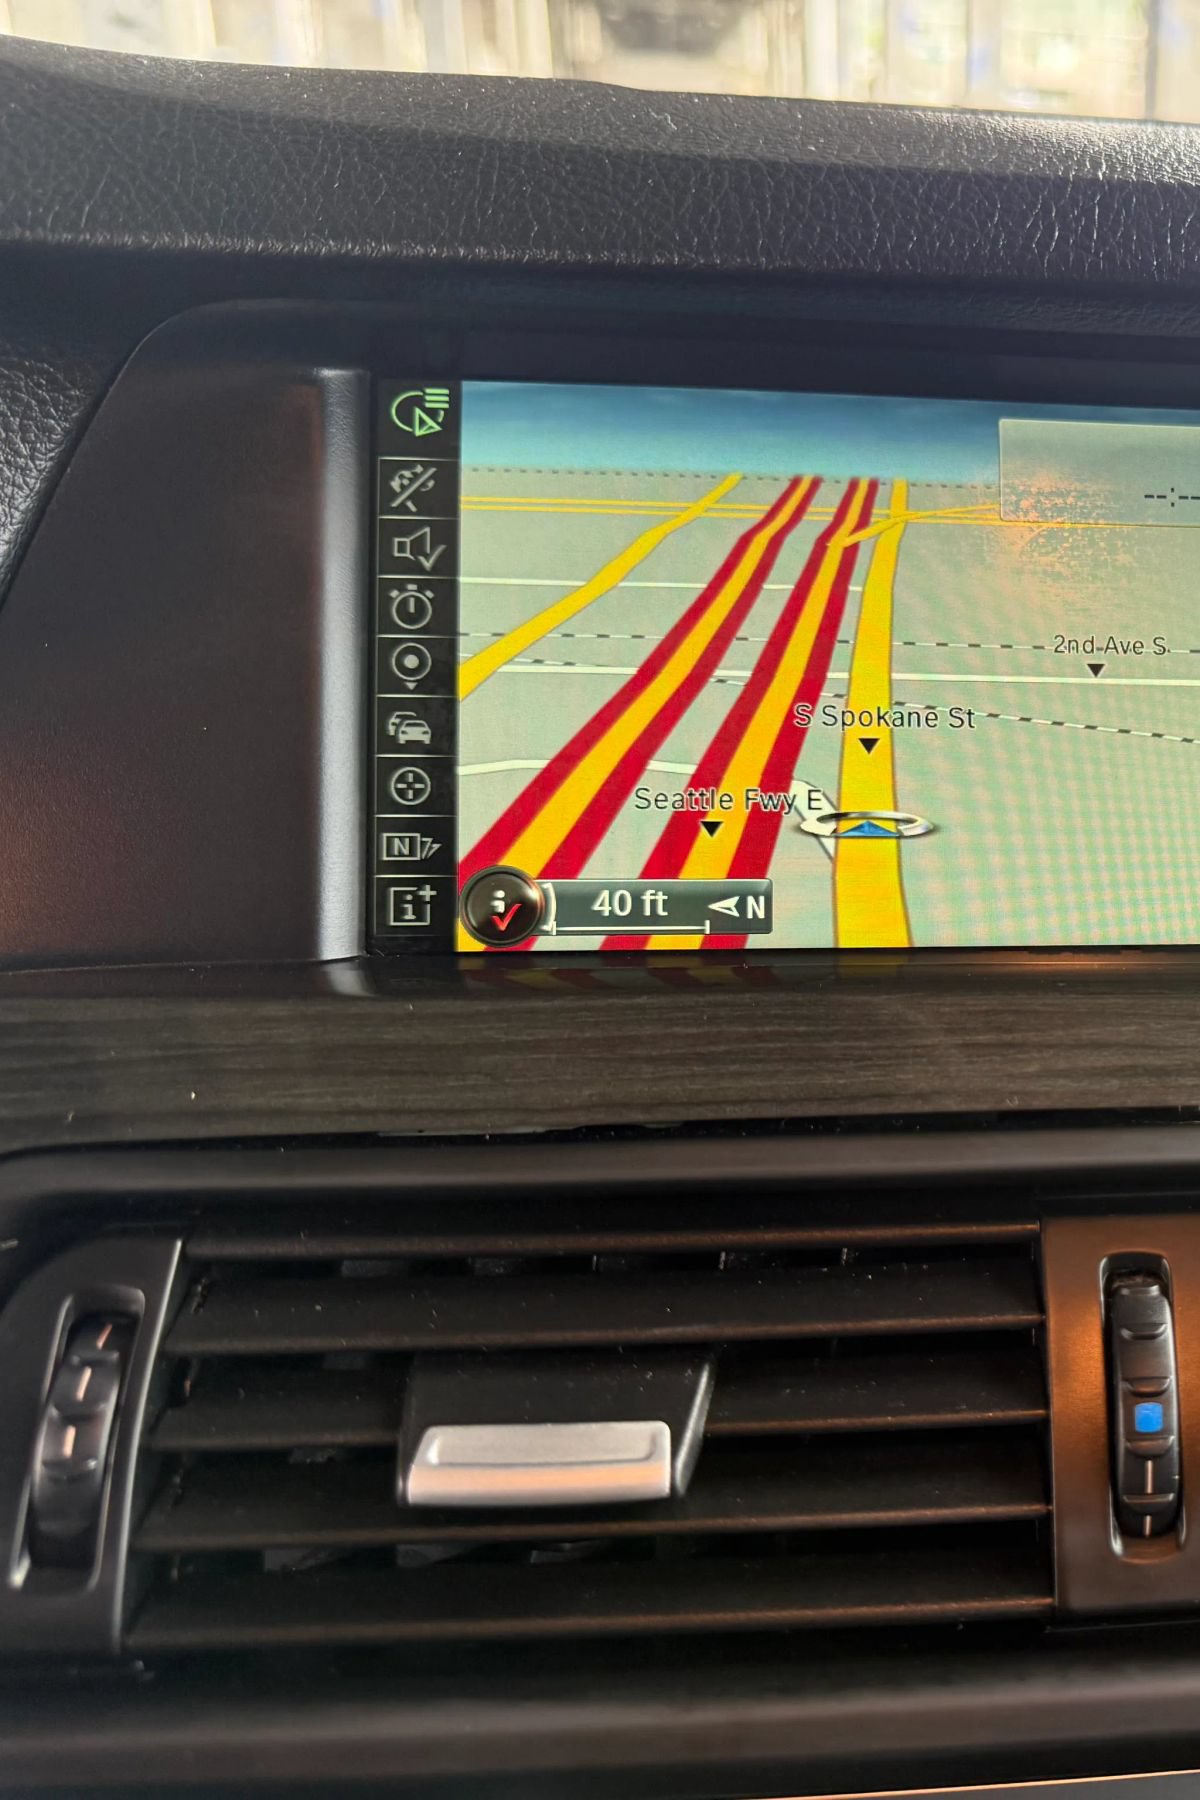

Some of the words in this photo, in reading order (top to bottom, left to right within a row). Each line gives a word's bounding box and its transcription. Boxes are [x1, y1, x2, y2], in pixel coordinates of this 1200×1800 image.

[1053, 634, 1095, 655] 2nd
[1103, 635, 1145, 656] Ave
[1152, 636, 1167, 656] S
[794, 704, 813, 728] S
[820, 705, 940, 731] Spokane
[948, 706, 976, 729] St
[634, 787, 734, 810] Seattle
[744, 788, 798, 815] Fwy
[807, 789, 824, 811] E
[591, 889, 632, 917] 40
[640, 889, 669, 917] ft
[746, 894, 766, 919] N
